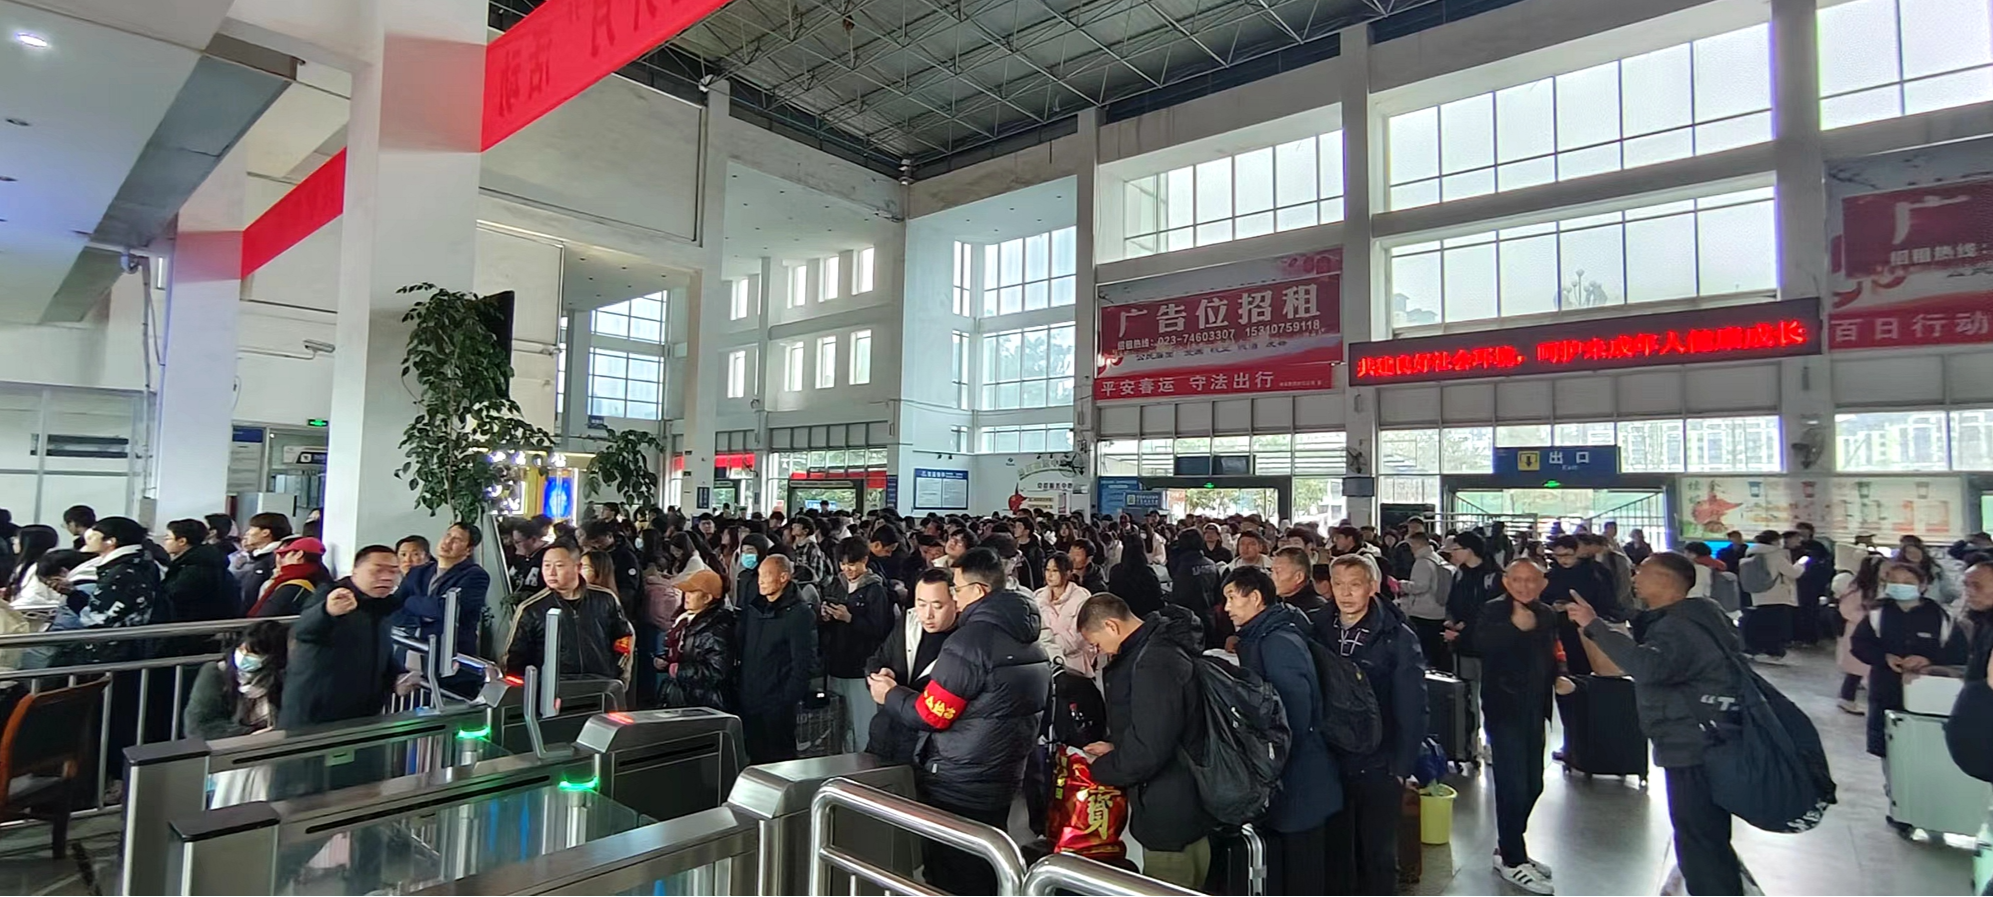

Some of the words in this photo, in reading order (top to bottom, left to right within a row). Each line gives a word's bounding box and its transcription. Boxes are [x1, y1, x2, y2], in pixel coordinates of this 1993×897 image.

[1893, 195, 1971, 245] 广
[1118, 283, 1321, 338] 广告位招租
[1244, 320, 1320, 338] 15310759118
[1831, 312, 1989, 342] 百日行动
[1102, 377, 1175, 396] 平安春运
[1189, 371, 1275, 391] 守法出行
[1549, 450, 1590, 464] 出口
